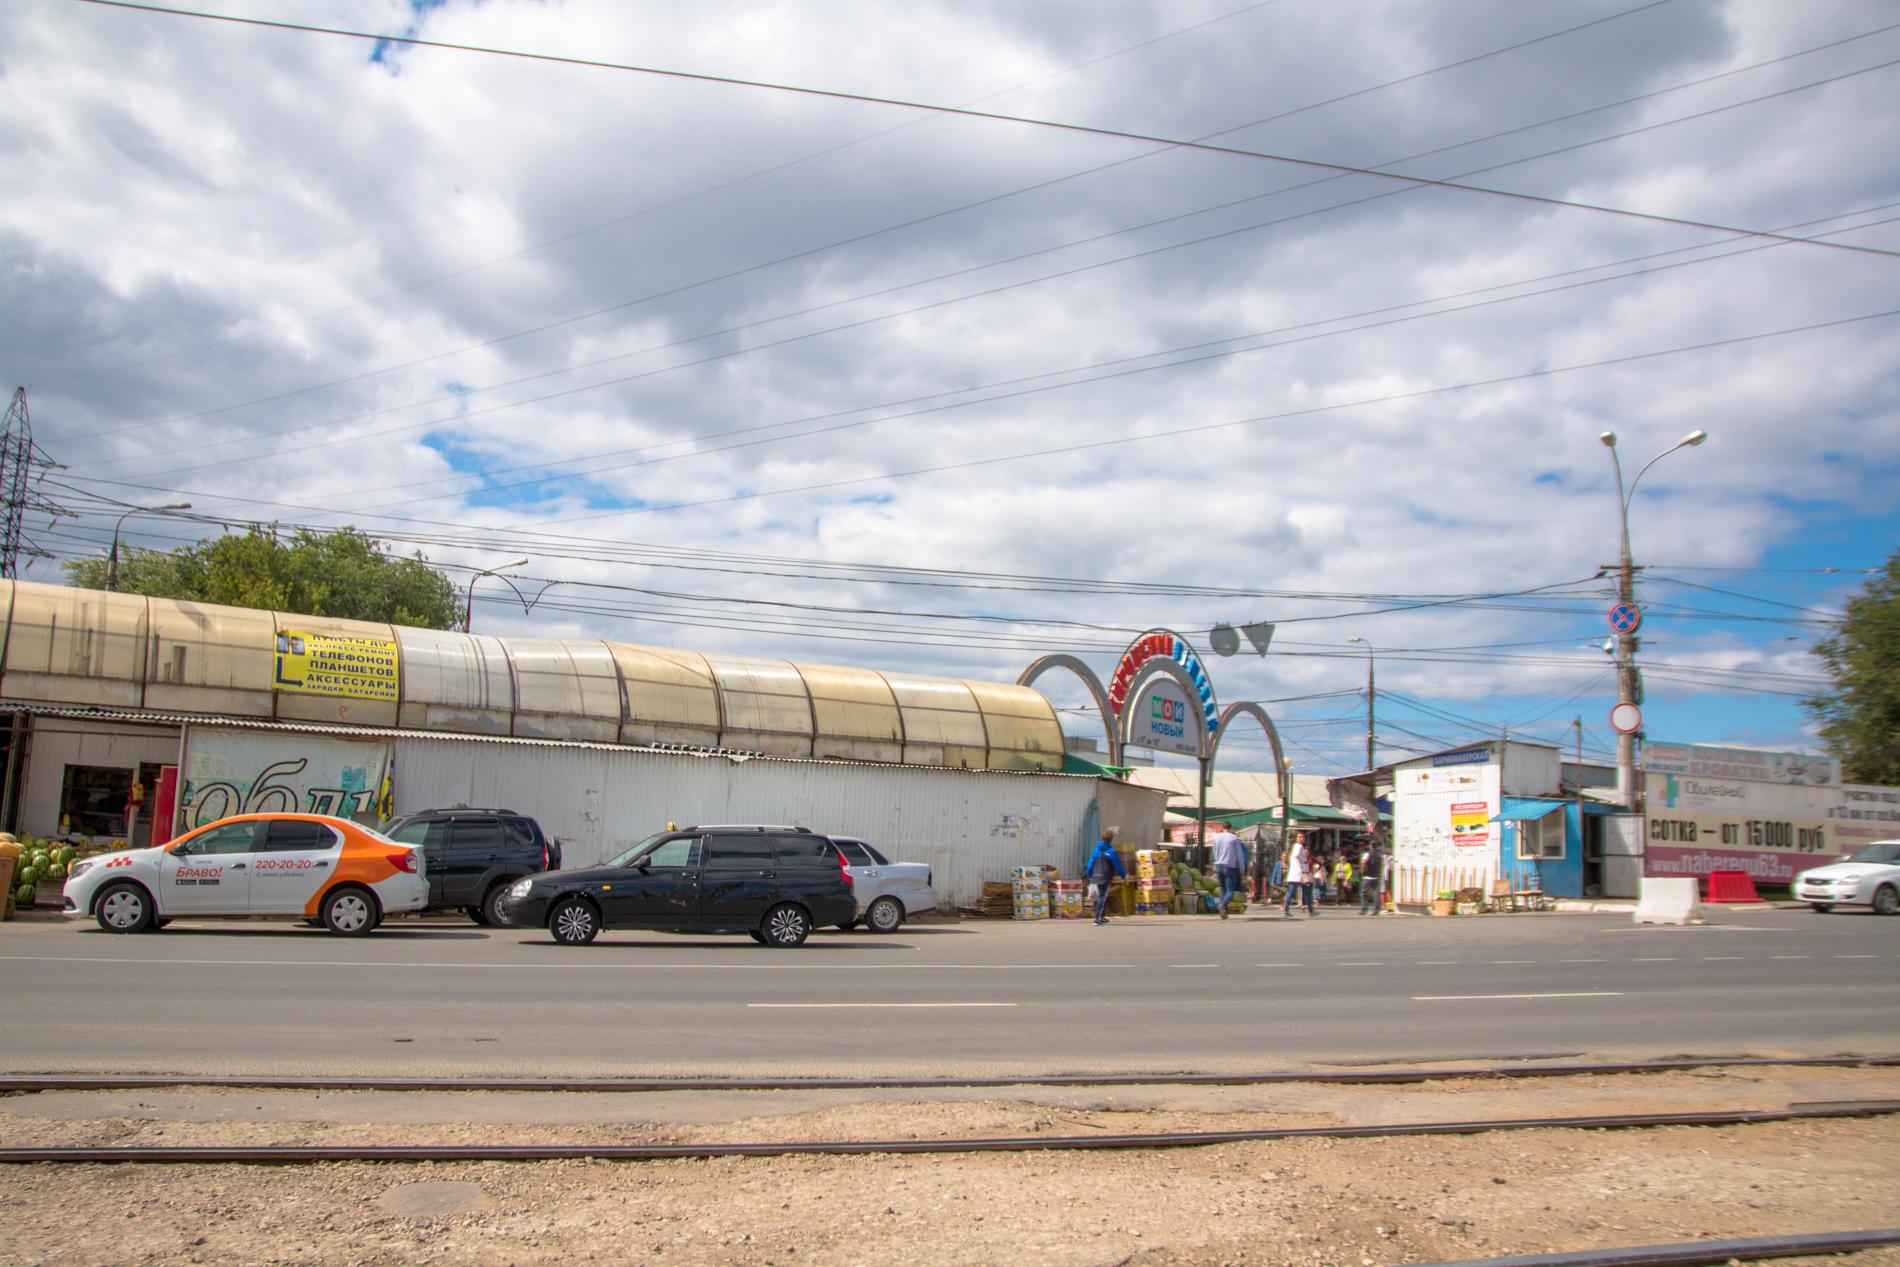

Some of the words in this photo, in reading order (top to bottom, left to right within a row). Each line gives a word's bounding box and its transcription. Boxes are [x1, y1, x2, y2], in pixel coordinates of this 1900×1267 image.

[311, 649, 394, 666] ТЕЛЕФОНОВ
[309, 659, 394, 677] ПЛАНШЕТОВ
[306, 673, 396, 690] АКСЕССУАРЫ
[306, 684, 345, 693] ЗАРЯДКИ
[1151, 721, 1185, 738] НОВЫЙ
[1650, 818, 1698, 842] сотка
[1722, 823, 1740, 845] от
[1798, 824, 1825, 853] руб
[255, 859, 312, 869] 220-20-20
